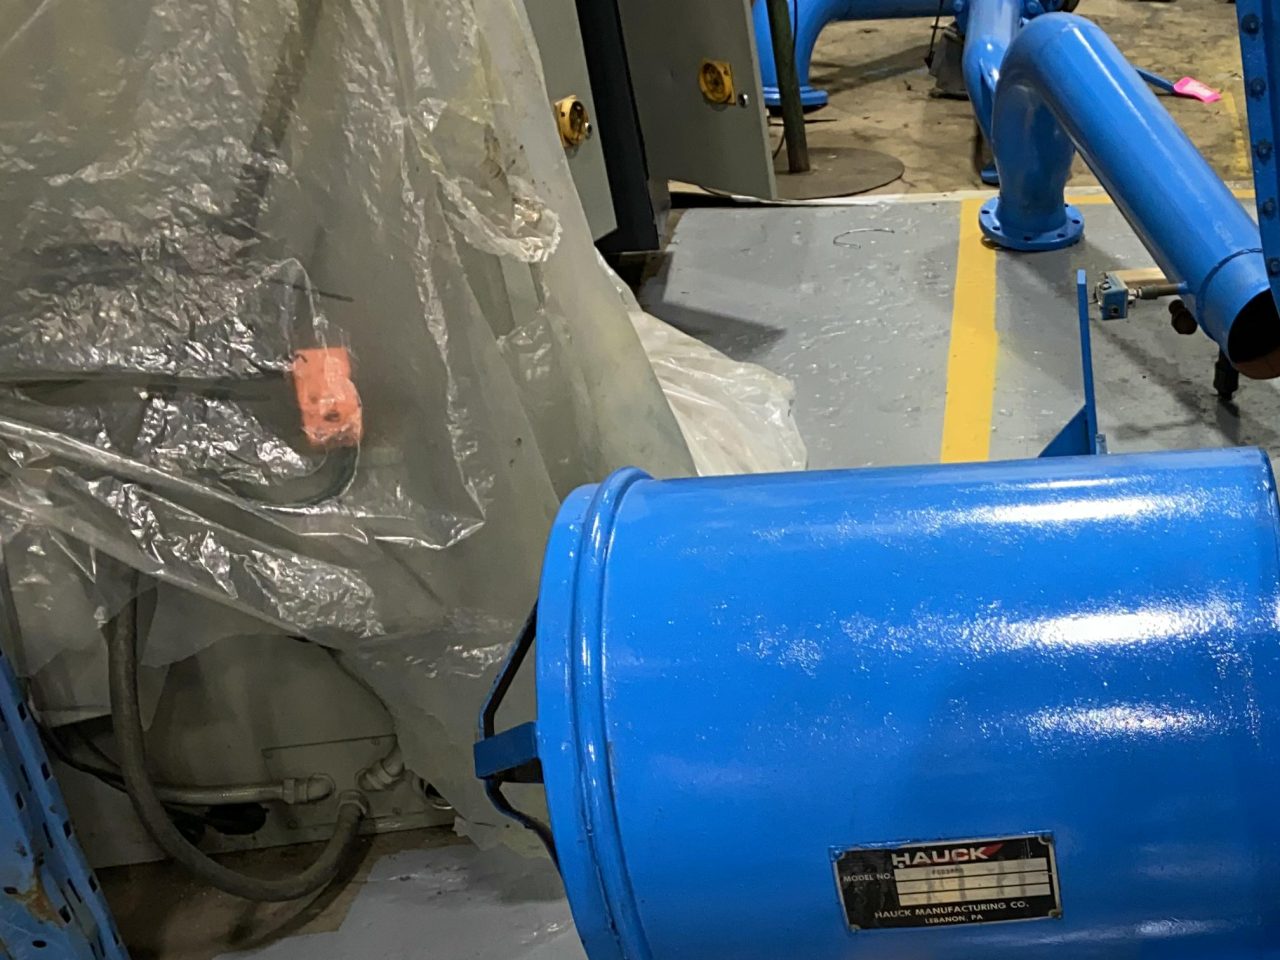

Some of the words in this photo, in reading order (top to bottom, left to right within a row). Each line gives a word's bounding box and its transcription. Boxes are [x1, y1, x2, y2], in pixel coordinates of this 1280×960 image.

[891, 846, 988, 867] HAUCK
[843, 873, 874, 883] MODEL
[874, 909, 912, 919] HAUCK
[915, 901, 1007, 916] MANUFACTURING
[1010, 900, 1030, 909] CO.
[970, 913, 984, 921] PA
